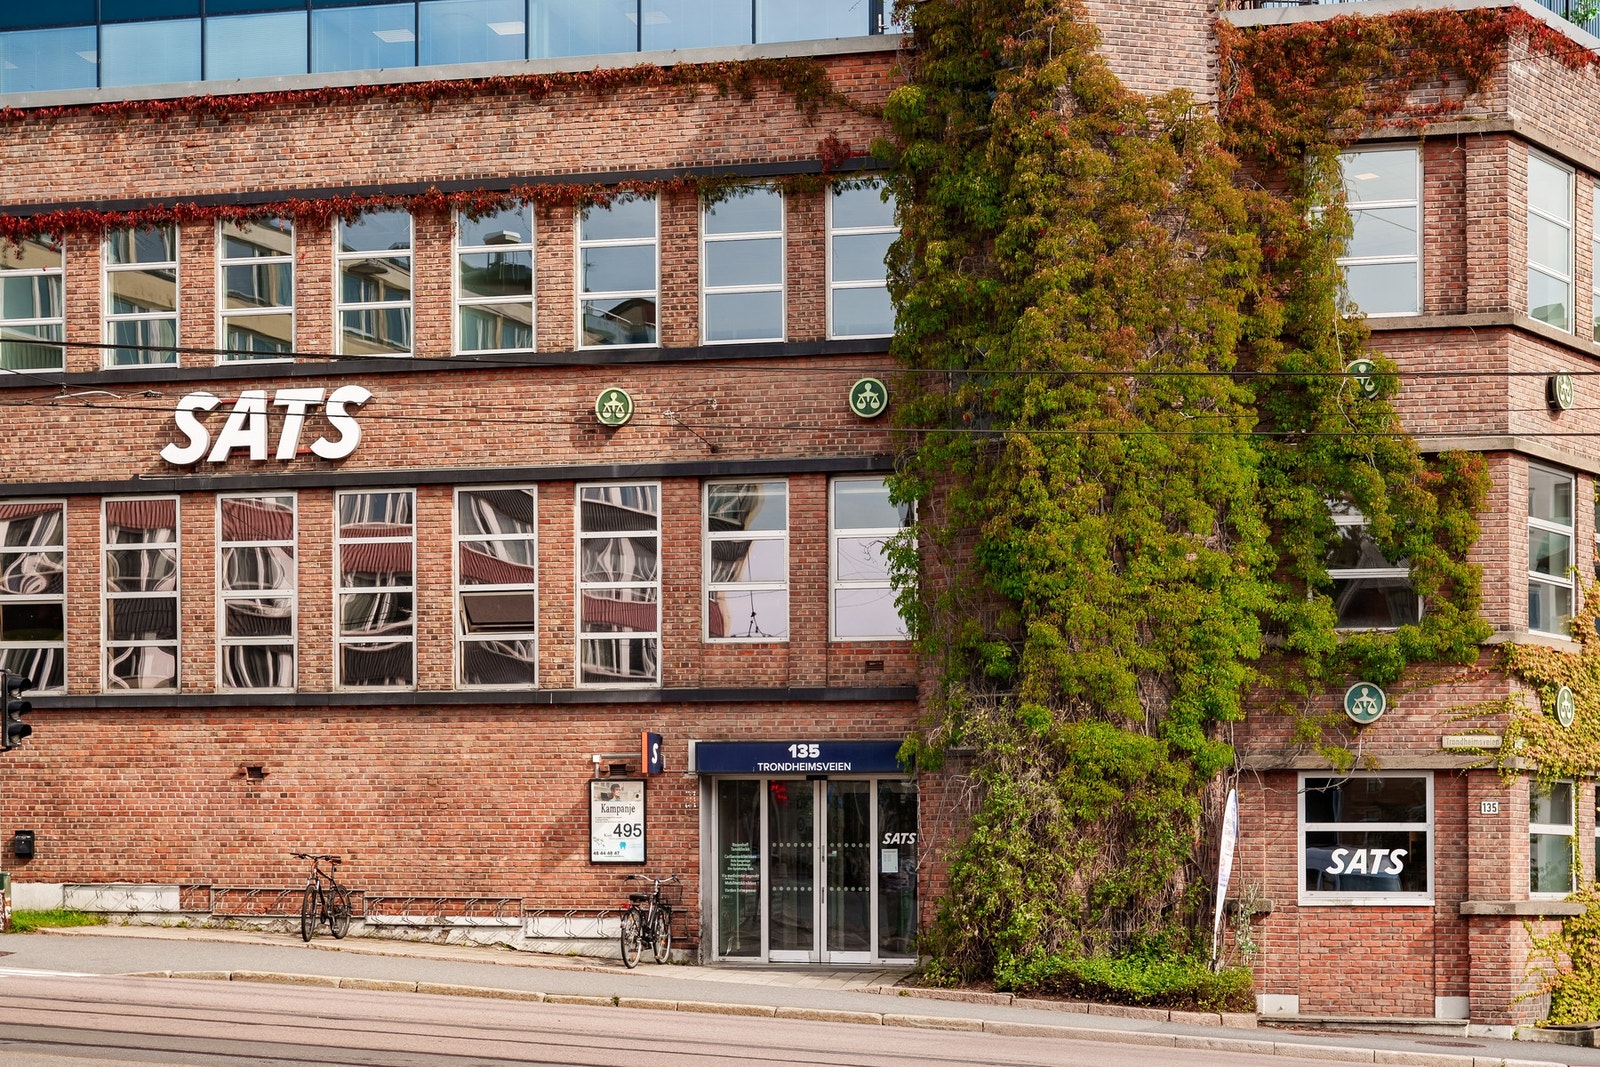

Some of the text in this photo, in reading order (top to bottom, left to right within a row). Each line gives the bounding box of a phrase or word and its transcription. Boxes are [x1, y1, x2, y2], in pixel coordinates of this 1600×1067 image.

[160, 385, 373, 466] SATS
[651, 742, 659, 764] S
[787, 743, 820, 759] 135
[757, 762, 852, 772] TRONDHEIMSVEIEN
[601, 803, 636, 815] Kampanje
[1483, 802, 1497, 813] 135
[613, 823, 642, 837] 495
[882, 832, 917, 845] SATS
[1326, 848, 1408, 875] SATS
